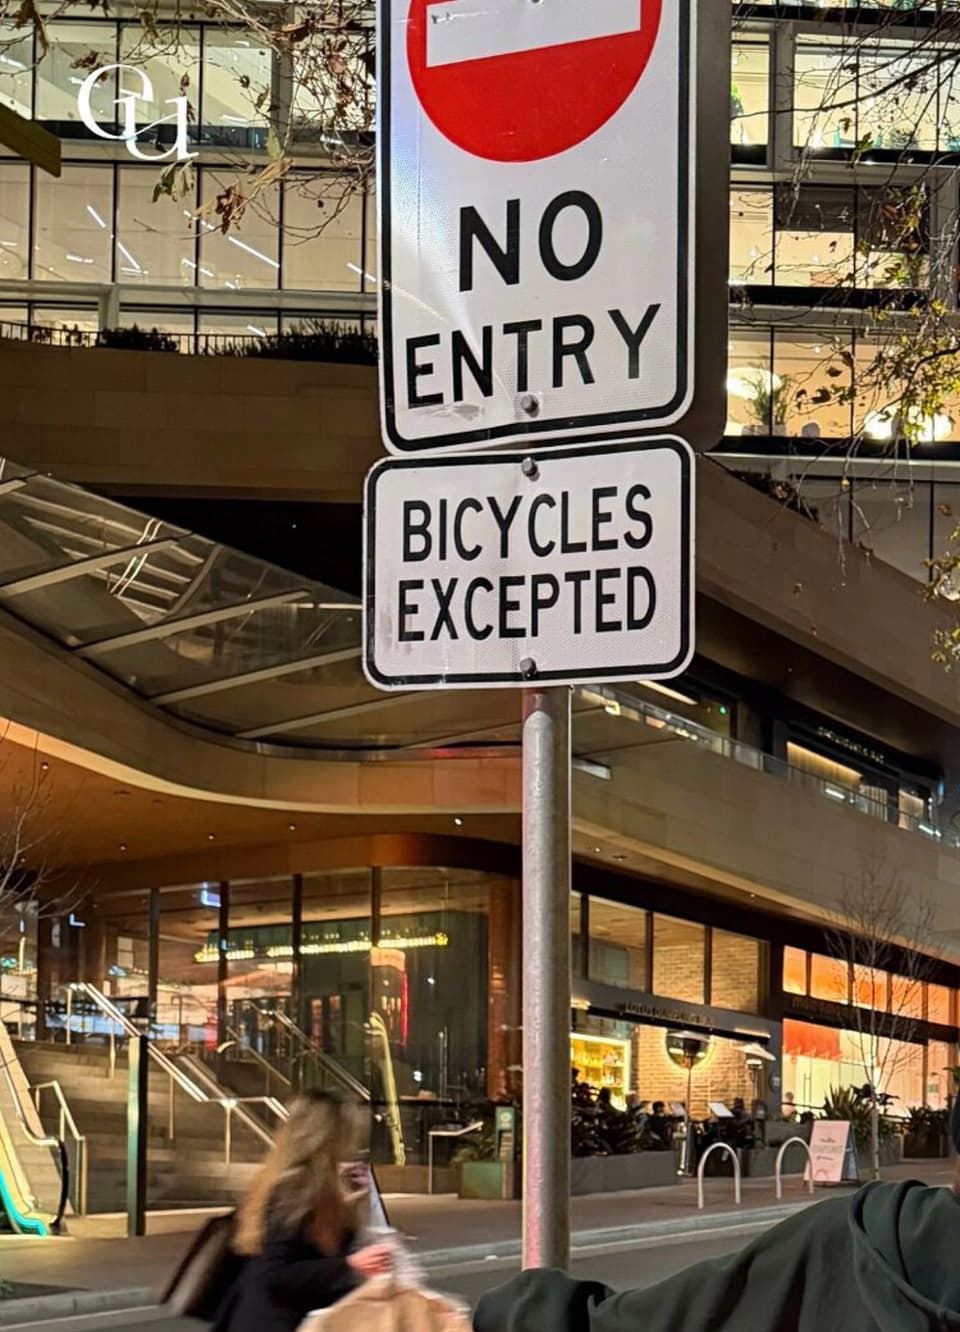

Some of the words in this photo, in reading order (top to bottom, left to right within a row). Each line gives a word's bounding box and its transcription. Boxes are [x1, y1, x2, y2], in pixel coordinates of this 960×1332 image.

[458, 189, 603, 293] NO
[405, 303, 662, 410] ENTRY
[402, 483, 654, 563] BICYCLES
[398, 565, 657, 643] EXCEPTED
